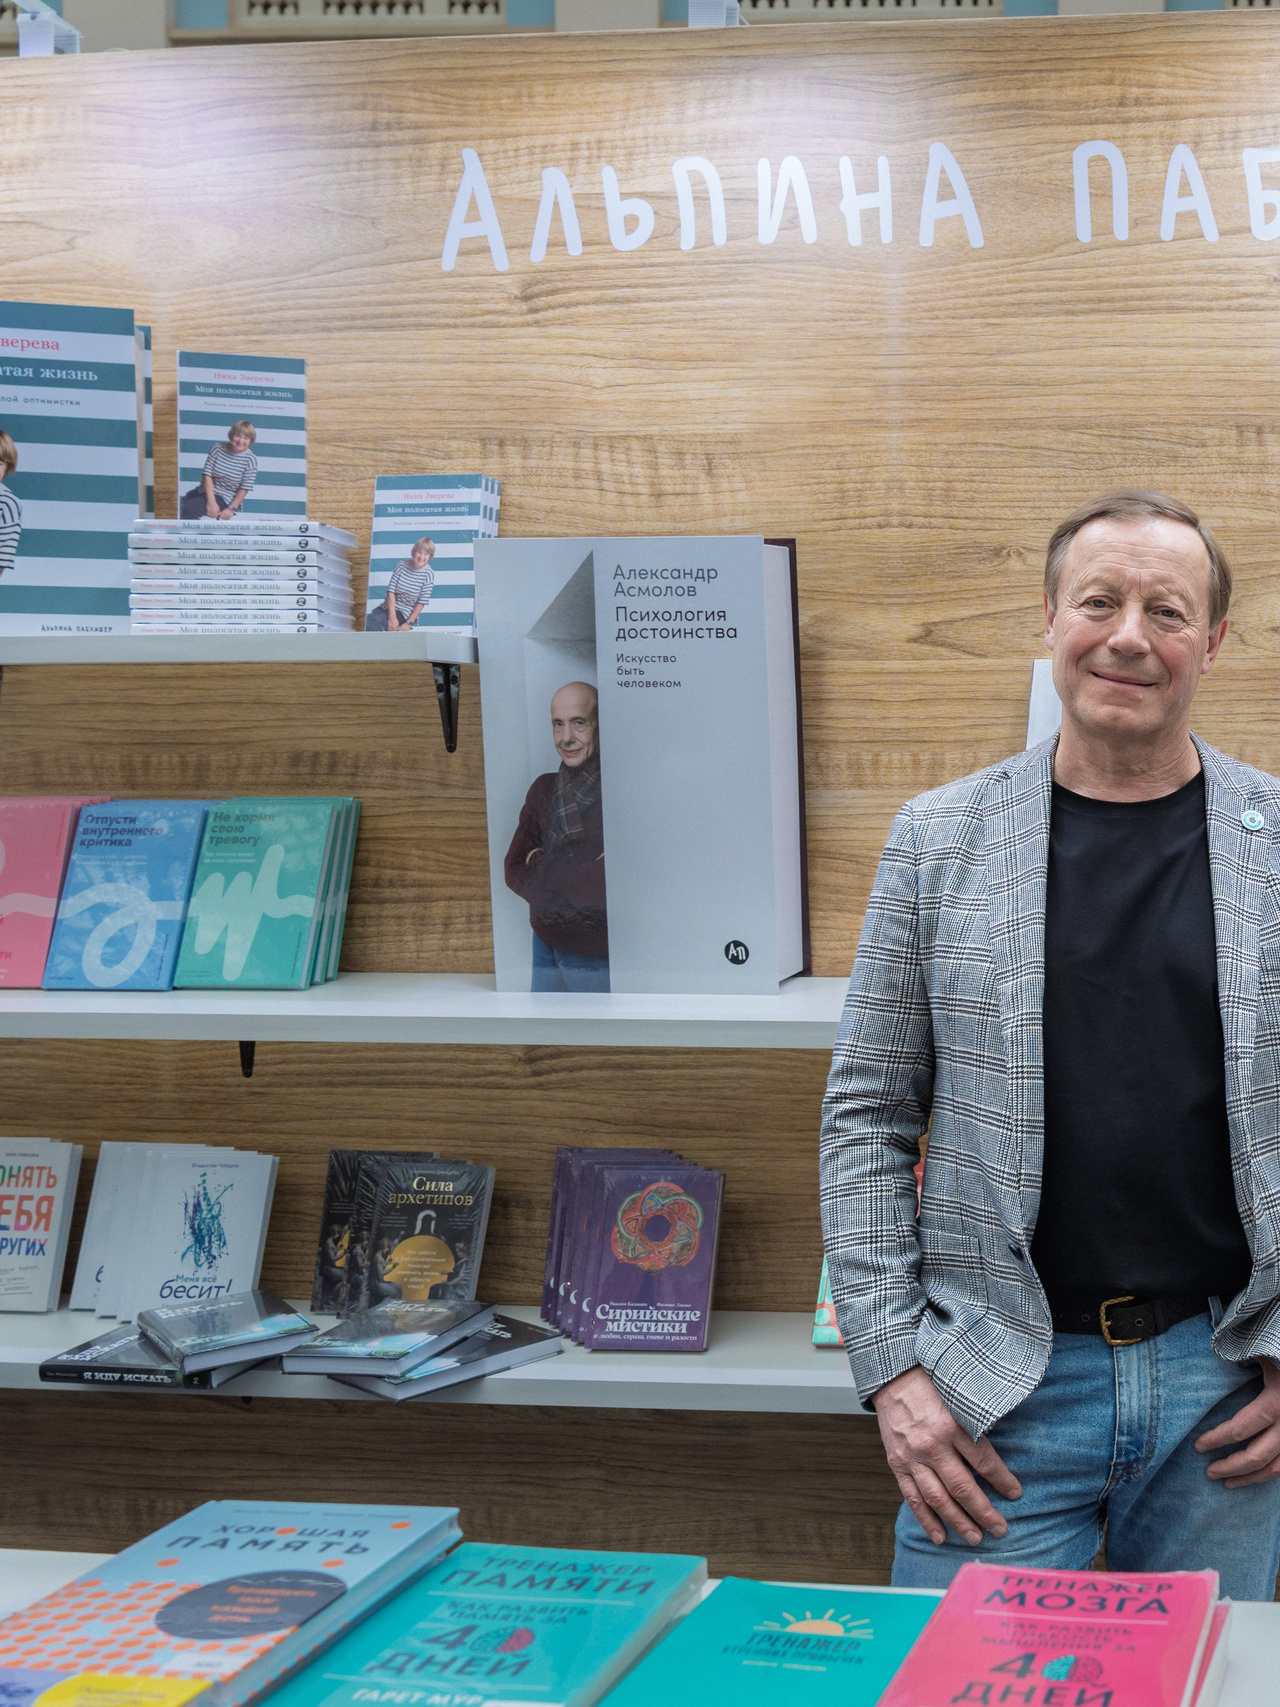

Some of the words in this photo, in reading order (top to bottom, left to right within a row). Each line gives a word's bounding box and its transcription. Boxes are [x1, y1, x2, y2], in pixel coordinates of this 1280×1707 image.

[441, 142, 985, 271] АЛЬПИНА
[40, 368, 98, 381] жизнь
[195, 385, 214, 393] Моя
[216, 387, 261, 396] полосатая
[264, 390, 293, 398] жизнь
[23, 397, 80, 406] оптимистки
[404, 506, 442, 514] полосатая
[182, 522, 200, 530] Моя
[203, 523, 250, 531] полосатая
[178, 536, 198, 545] Моя
[200, 538, 249, 546] полосатая
[177, 551, 196, 559] Моя
[199, 552, 247, 560] полосатая
[249, 553, 279, 561] жизнь
[613, 564, 719, 584] Александр
[201, 582, 248, 590] полосатая
[613, 582, 697, 598] Асмолов
[179, 612, 198, 620] Моя
[201, 612, 248, 620] полосатая
[251, 612, 281, 620] жизнь
[615, 606, 727, 622] Психология
[615, 625, 738, 642] достоинства
[616, 653, 677, 666] Искусство
[617, 666, 645, 676] быть
[617, 679, 682, 688] человеком
[85, 814, 137, 827] Отпусти
[213, 812, 231, 822] Не
[82, 827, 163, 838] внутреннего
[211, 825, 245, 833] свою
[79, 838, 132, 849] критика
[209, 836, 260, 847] тревогу
[412, 1176, 453, 1192] Сила
[388, 1192, 474, 1208] архетипов
[175, 1274, 200, 1283] Меня
[202, 1275, 218, 1283] всё
[160, 1278, 233, 1299] бесит!
[595, 1304, 700, 1324] Сирийские
[605, 1321, 687, 1334] мистики
[94, 1372, 121, 1382] ИДУ
[123, 1373, 171, 1383] ИСКАТЬ
[166, 1536, 370, 1555] ПАМЯТЬ
[481, 1556, 652, 1576] ТРЕНАЖЕР
[440, 1570, 656, 1596] ПАМЯТИ
[1000, 1575, 1174, 1594] ТРЕНАЖЕР
[982, 1589, 1170, 1615] МОЗГА
[745, 1633, 860, 1654] ТРЕНАЖЕР
[367, 1651, 532, 1677] ДНЕЙ
[951, 1679, 1115, 1707] ДНЕЙ
